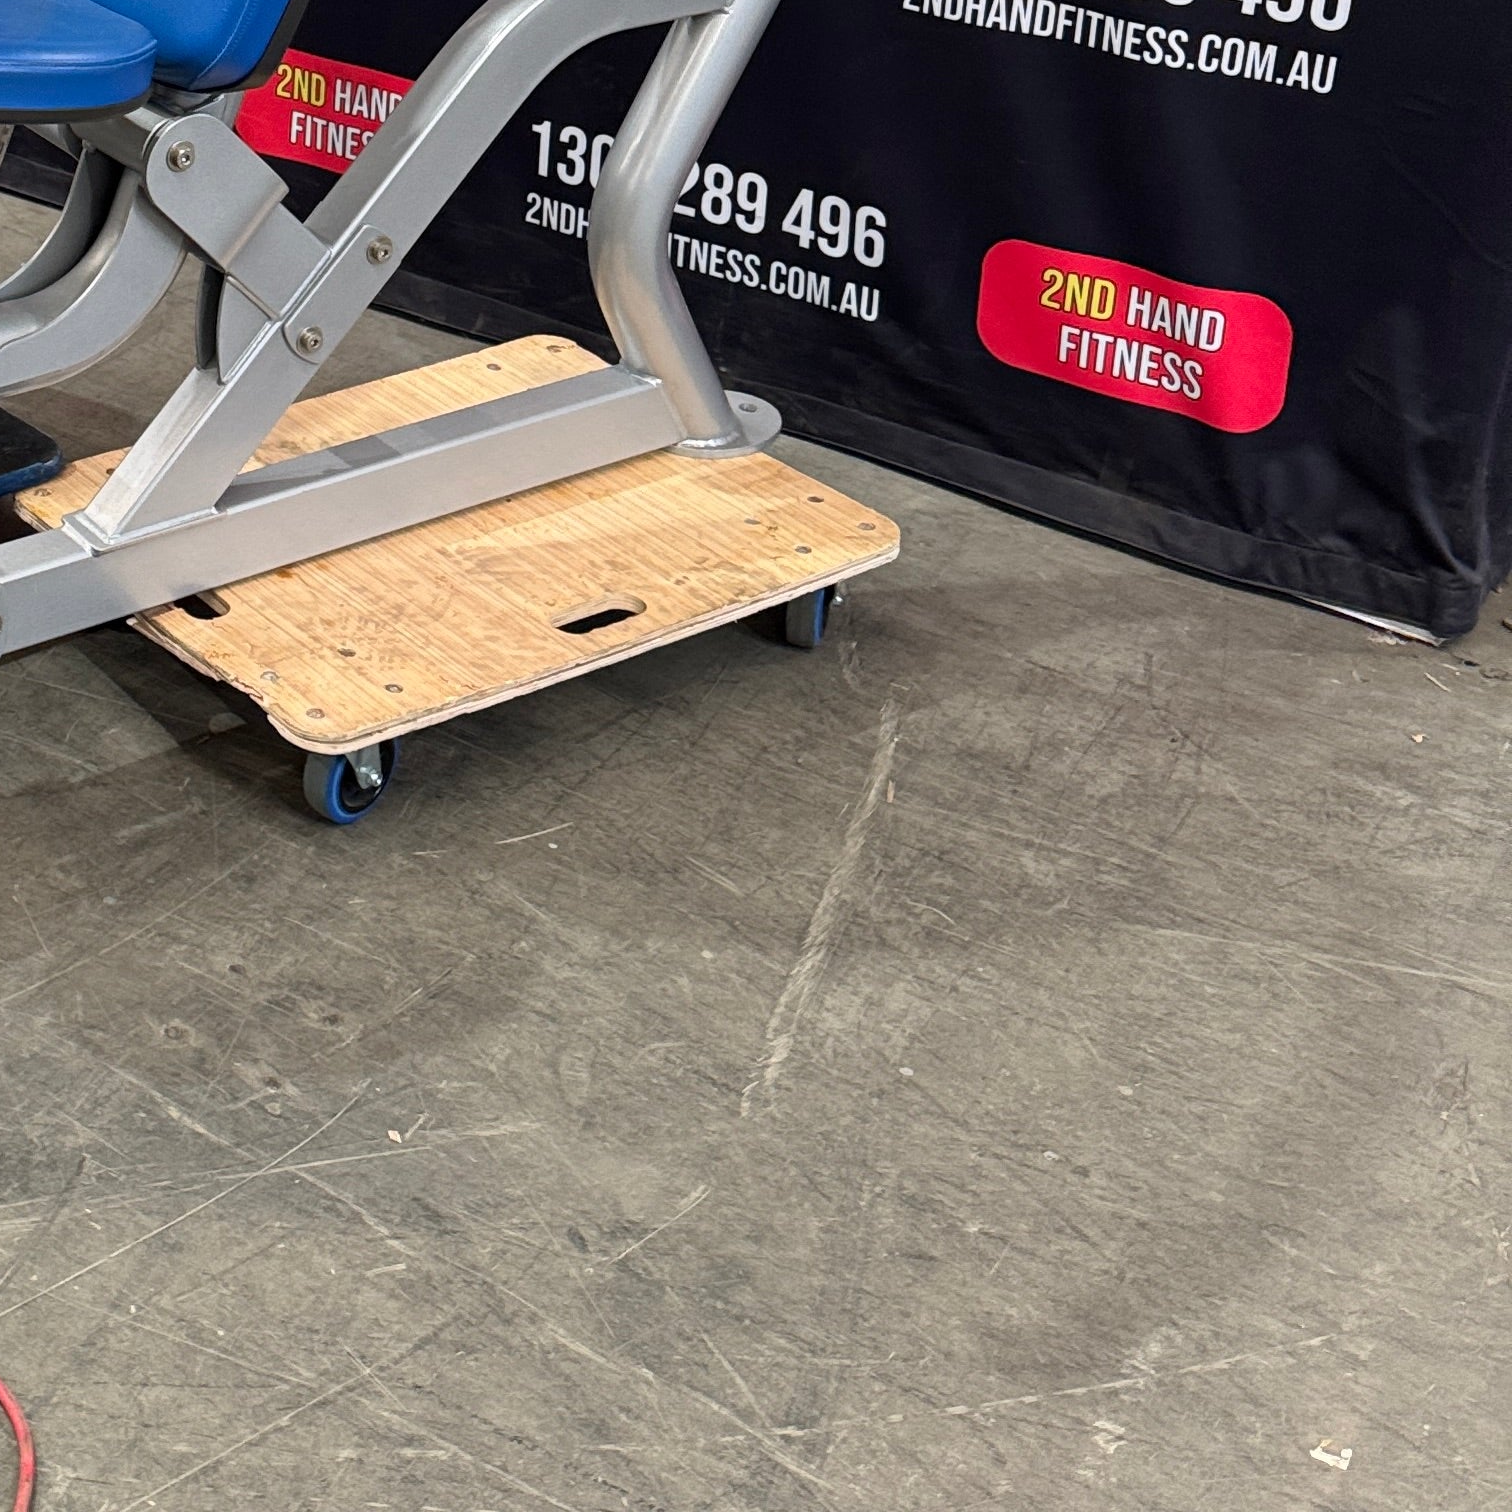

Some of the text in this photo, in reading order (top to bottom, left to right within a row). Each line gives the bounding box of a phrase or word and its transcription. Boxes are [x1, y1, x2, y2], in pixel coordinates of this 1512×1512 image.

[276, 63, 326, 107] 2ND
[531, 120, 620, 194] 130
[775, 188, 887, 274] 496
[1040, 268, 1225, 361] 2ND HAND
[1059, 318, 1211, 400] FITNESS
